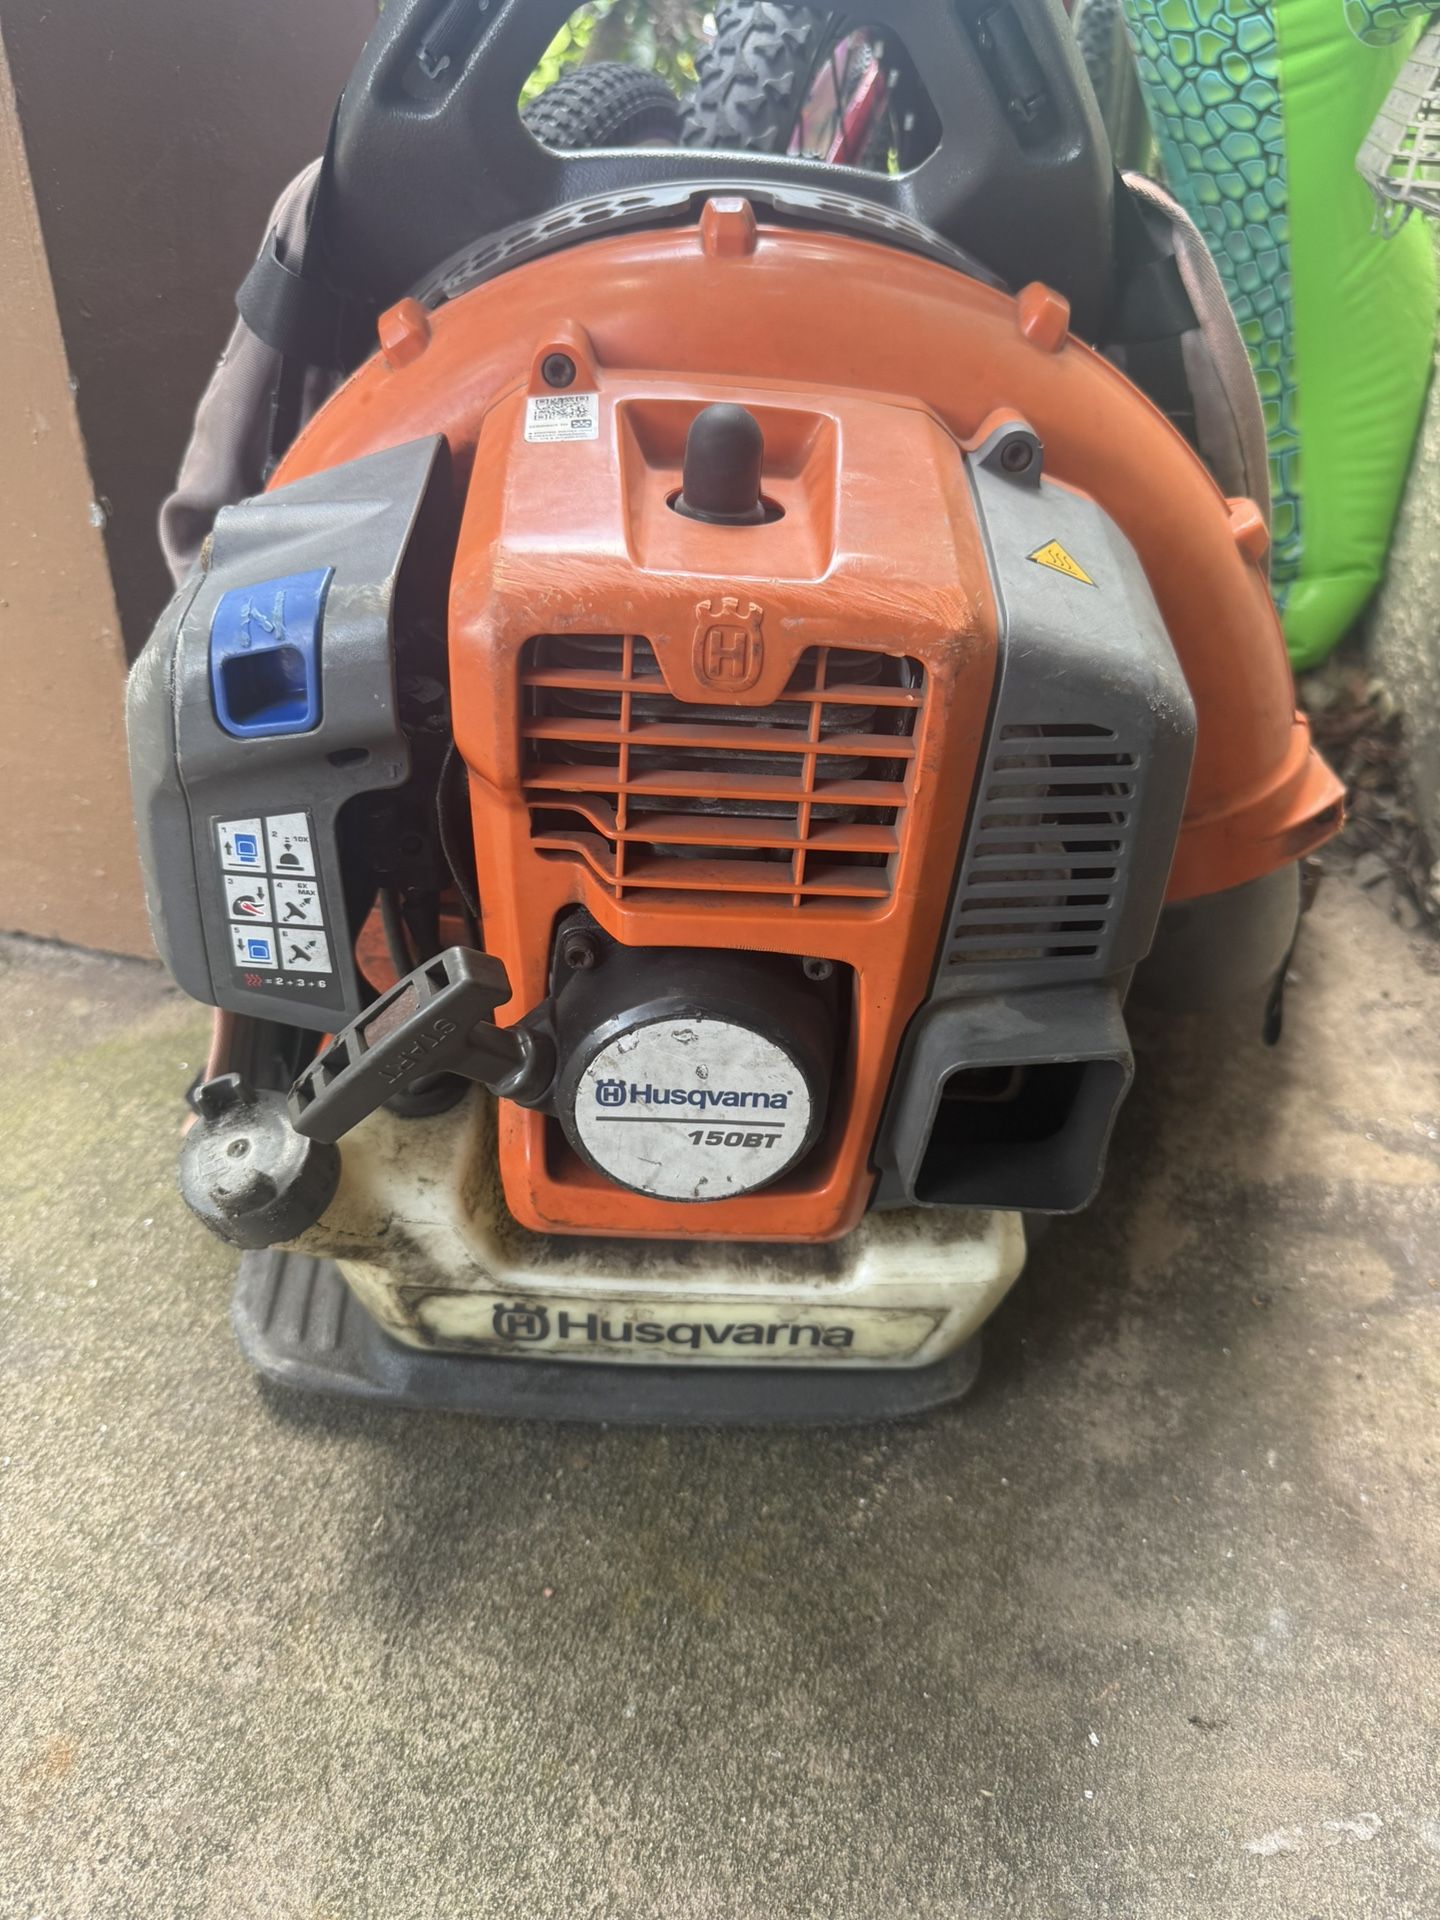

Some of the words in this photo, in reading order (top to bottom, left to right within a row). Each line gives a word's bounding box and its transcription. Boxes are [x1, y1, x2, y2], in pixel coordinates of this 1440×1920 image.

[275, 976, 285, 986] 2
[296, 978, 306, 988] 3
[317, 979, 328, 989] 6
[378, 1018, 458, 1084] START
[629, 1083, 789, 1110] Husqvarna
[688, 1130, 783, 1149] 150BT
[557, 1310, 855, 1348] Husqvarna
